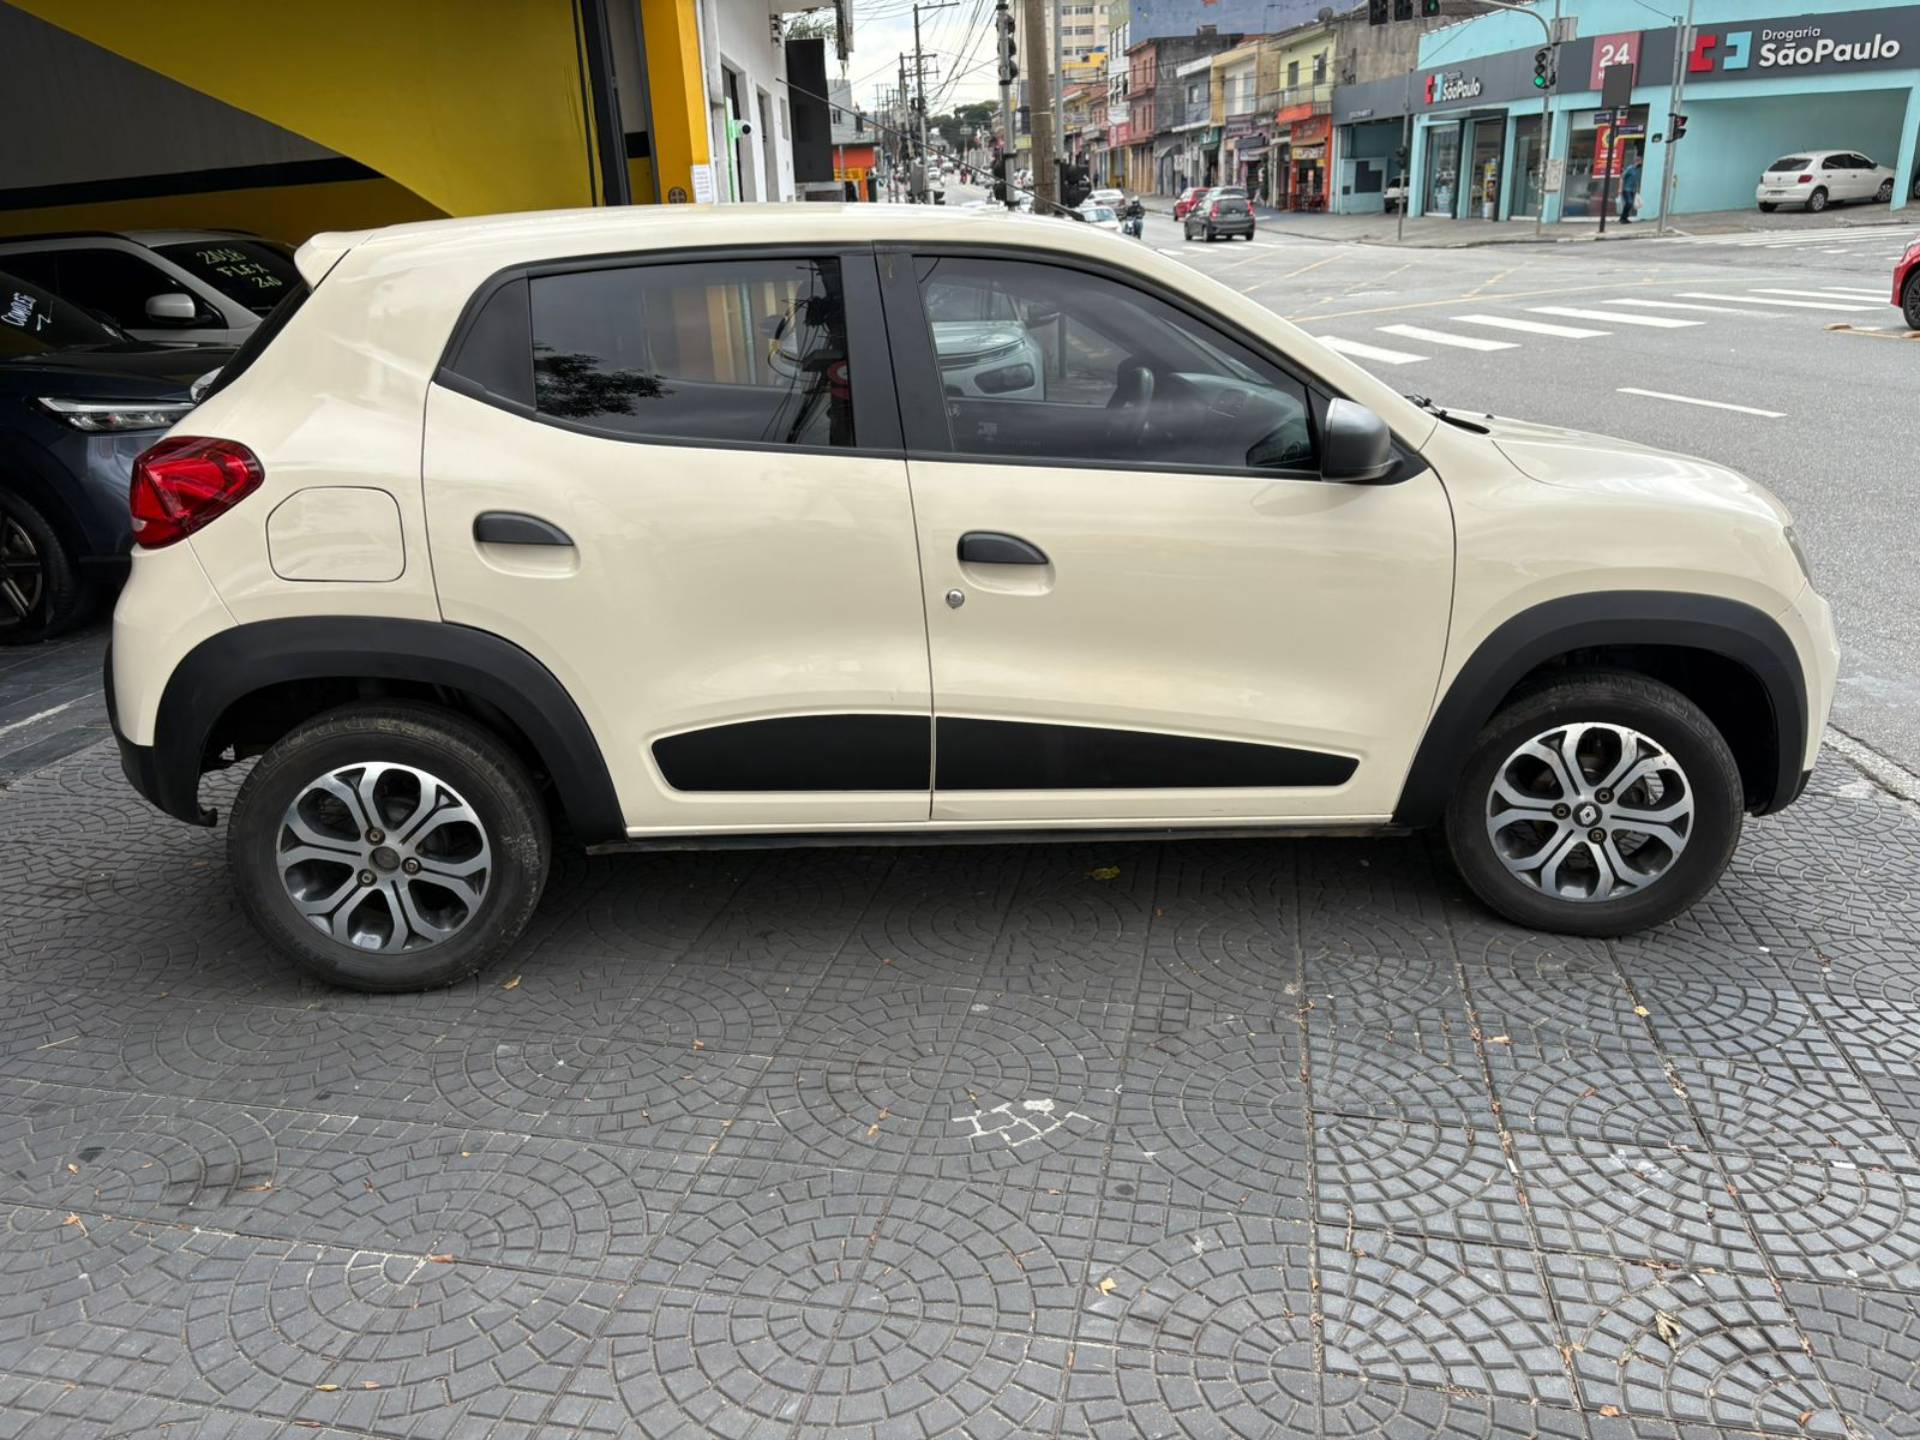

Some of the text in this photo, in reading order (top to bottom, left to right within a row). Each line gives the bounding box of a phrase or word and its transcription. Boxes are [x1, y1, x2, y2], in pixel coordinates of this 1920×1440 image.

[1762, 26, 1821, 41] Drogaria
[1599, 43, 1630, 67] 24
[1759, 33, 1900, 67] SãoPaulo
[216, 263, 269, 277] FLEX
